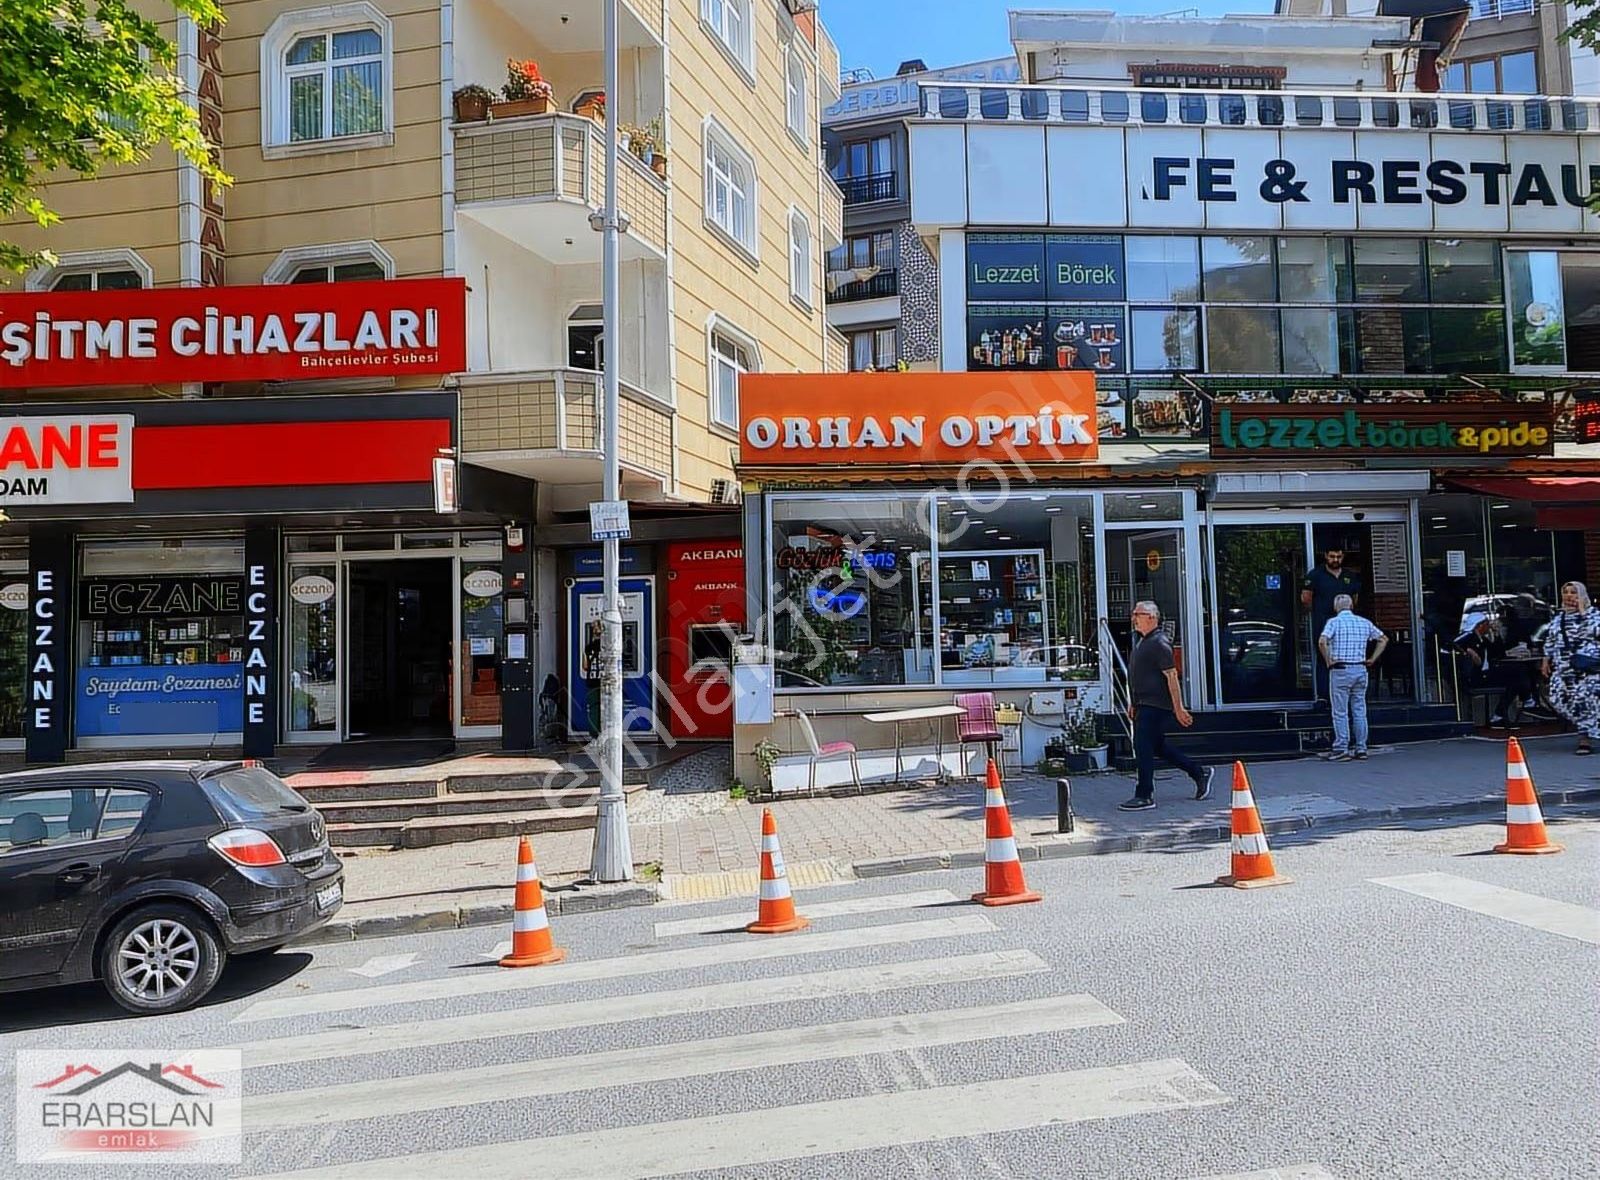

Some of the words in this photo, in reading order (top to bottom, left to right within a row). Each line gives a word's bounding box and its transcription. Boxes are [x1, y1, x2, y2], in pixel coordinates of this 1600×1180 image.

[1142, 157, 1237, 202] FE
[1259, 159, 1307, 202] &
[974, 263, 1040, 283] Lezzet
[1057, 264, 1116, 284] Börek
[171, 307, 439, 357] CİHAZLARI
[301, 355, 388, 367] Bahçelievler
[392, 351, 439, 366] Şubesi
[746, 415, 926, 449] ORHAN
[939, 405, 1094, 446] OPTİK
[0, 423, 119, 470] ANE
[777, 547, 842, 568] Gözlük
[850, 550, 896, 568] Lens
[88, 582, 240, 614] ECZANE
[694, 582, 738, 591] AKBANK
[33, 571, 54, 728] ECZANE
[246, 565, 267, 723] ECZANE
[86, 676, 161, 698] Saydam
[162, 673, 242, 694] Eczanesi
